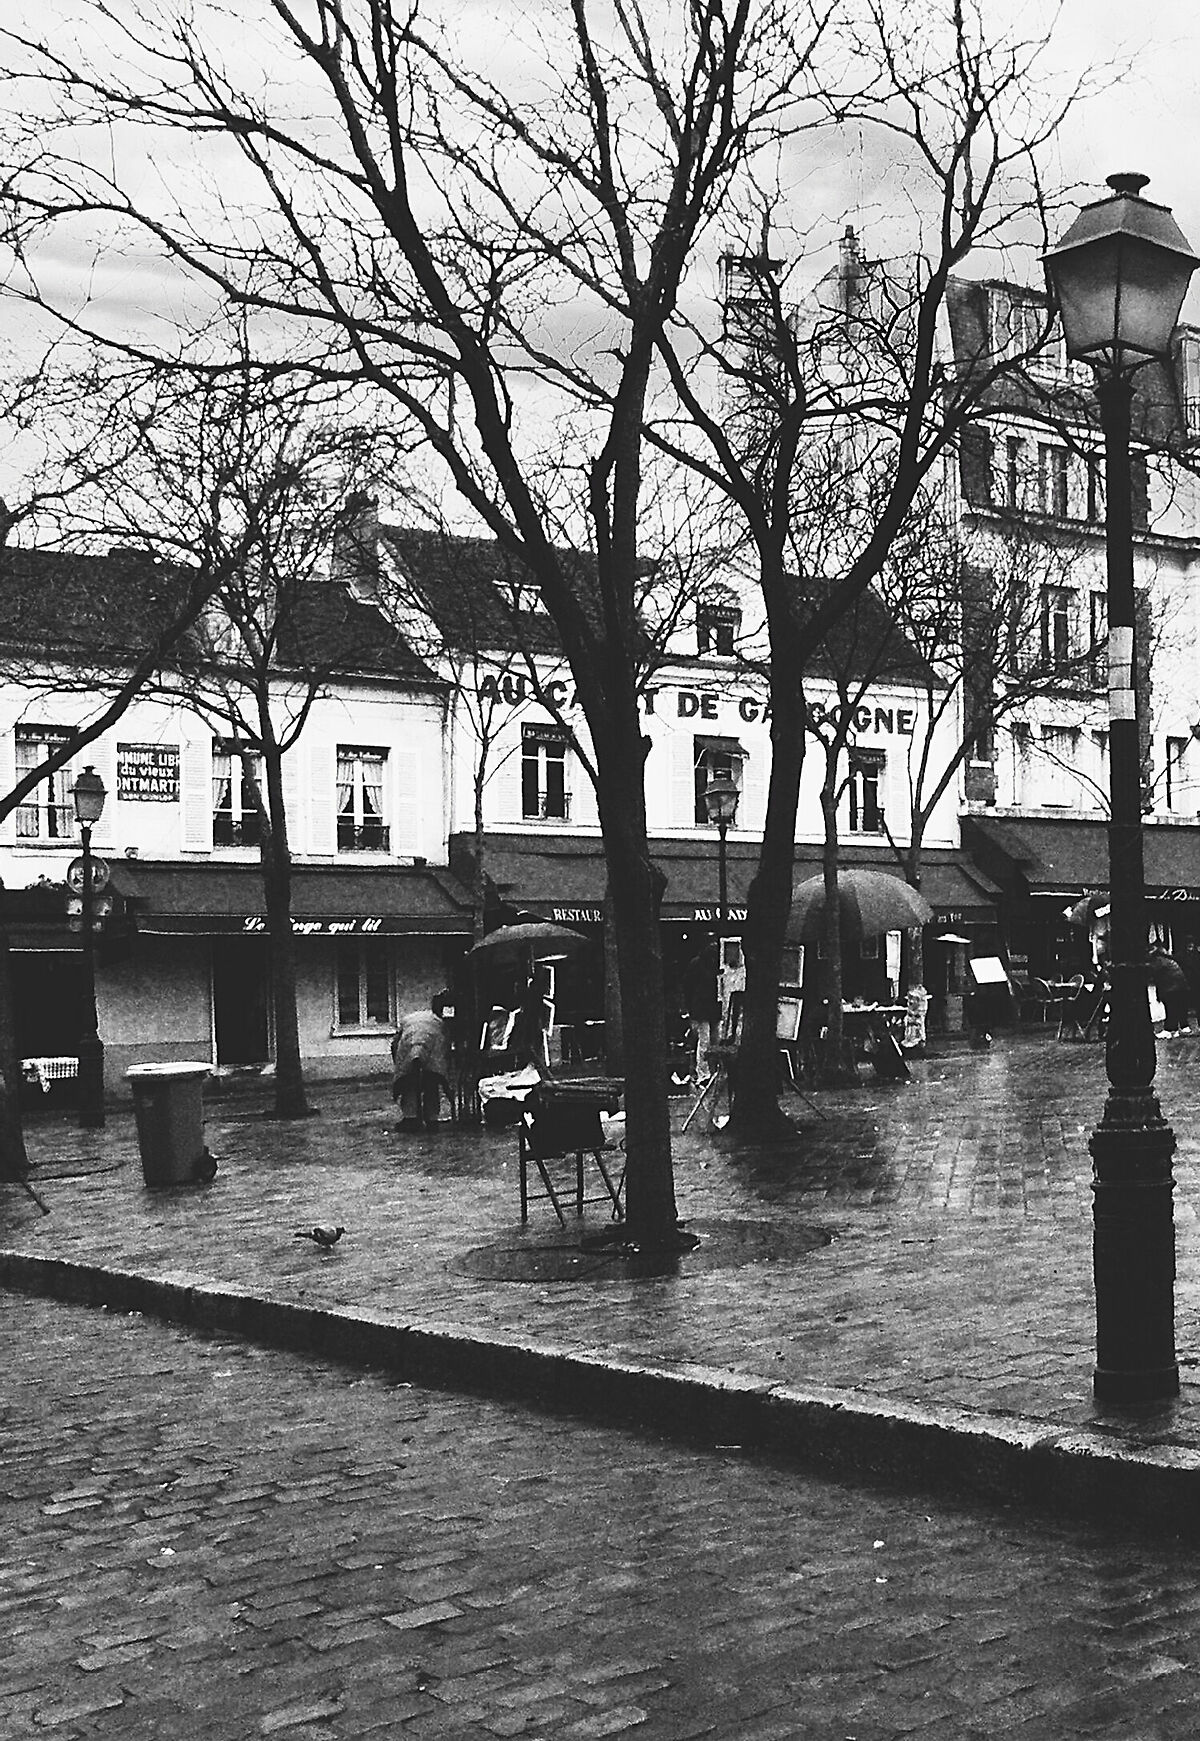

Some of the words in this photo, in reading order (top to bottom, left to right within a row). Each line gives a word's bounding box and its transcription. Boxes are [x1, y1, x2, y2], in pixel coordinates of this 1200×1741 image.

[478, 674, 525, 706] AU
[677, 692, 719, 720] DE
[120, 763, 136, 776] du
[138, 766, 174, 777] vieux
[553, 908, 602, 922] RESTAUR
[694, 909, 712, 921] AU
[242, 916, 266, 931] Le
[328, 919, 357, 935] qui
